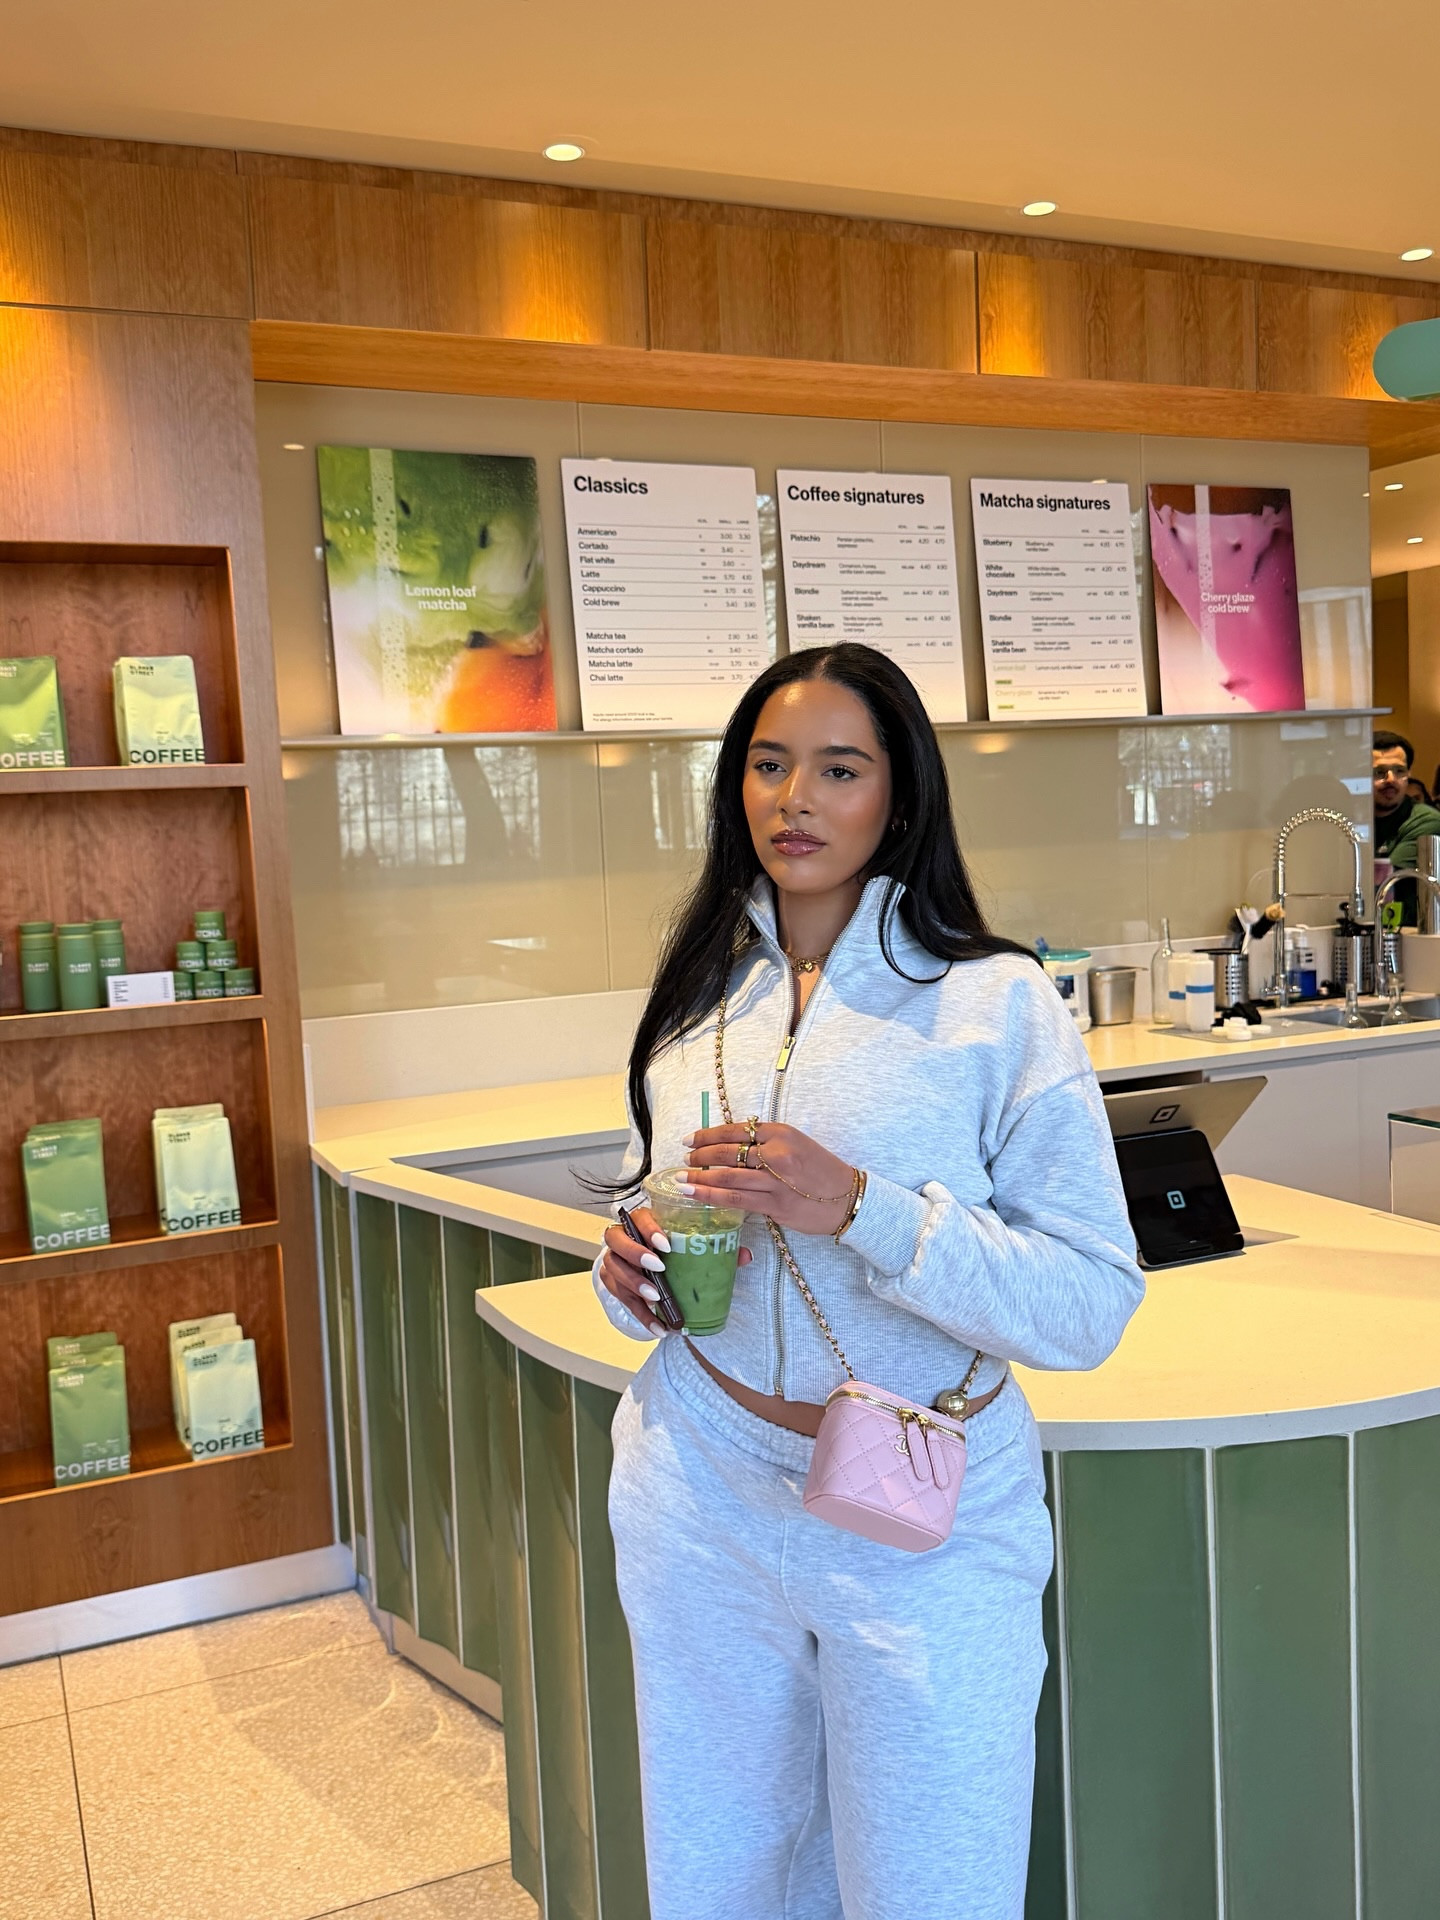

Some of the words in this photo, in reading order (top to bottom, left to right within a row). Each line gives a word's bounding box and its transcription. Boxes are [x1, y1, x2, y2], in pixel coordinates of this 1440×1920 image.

[574, 475, 649, 495] Classics
[787, 484, 841, 503] Coffee
[843, 487, 926, 506] signatures
[979, 493, 1034, 508] Matcha
[1036, 494, 1111, 512] signatures
[577, 527, 617, 537] Americano
[790, 534, 821, 542] Pistachio
[578, 541, 609, 550] Cortado
[983, 539, 1012, 547] Blueberry
[579, 556, 594, 564] Flat
[594, 556, 616, 564] white
[792, 560, 826, 569] Daydream
[580, 570, 600, 578] Latte
[404, 584, 451, 598] Lemon
[452, 585, 477, 598] loaf
[581, 584, 626, 593] Cappuccino
[794, 587, 819, 595] Blondie
[987, 589, 1018, 597] Daydream
[583, 598, 600, 606] Cold
[601, 598, 620, 606] brew
[1201, 592, 1231, 603] Cherry
[1231, 593, 1255, 603] glaze
[418, 599, 467, 612] matcha
[1207, 604, 1227, 613] cold
[1228, 604, 1250, 613] brew
[586, 632, 613, 640] Matcha
[587, 646, 614, 654] Matcha
[615, 646, 644, 654] cortado
[588, 660, 615, 668] Matcha
[616, 660, 633, 668] latte
[589, 674, 606, 682] Chai
[129, 748, 206, 764] COFFEE
[167, 1208, 242, 1232] COFFEE
[33, 1223, 111, 1250] COFFEE
[192, 1429, 265, 1455] COFFEE
[54, 1454, 130, 1480] COFFEE
